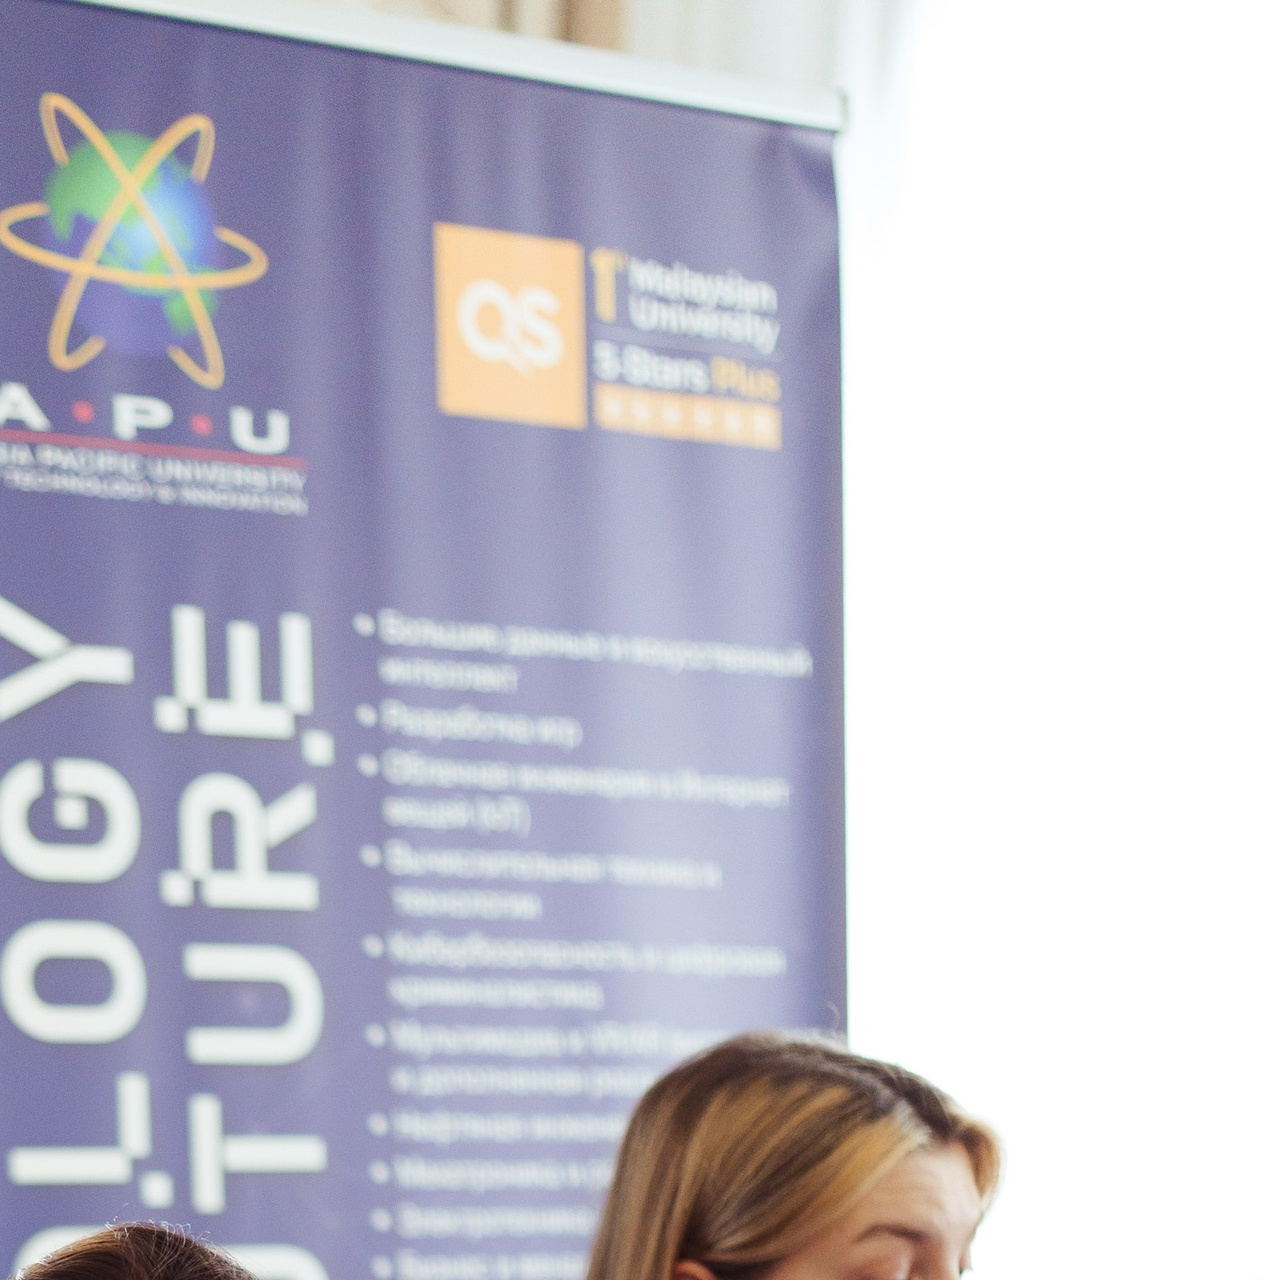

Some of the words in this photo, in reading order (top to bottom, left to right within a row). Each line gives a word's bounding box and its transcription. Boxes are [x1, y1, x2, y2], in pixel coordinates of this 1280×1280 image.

[456, 278, 565, 378] QS
[628, 295, 781, 356] University
[4, 467, 152, 502] TECHNOLOGY
[37, 444, 146, 480] PACIFIC
[147, 456, 308, 492] UNIVERSITY
